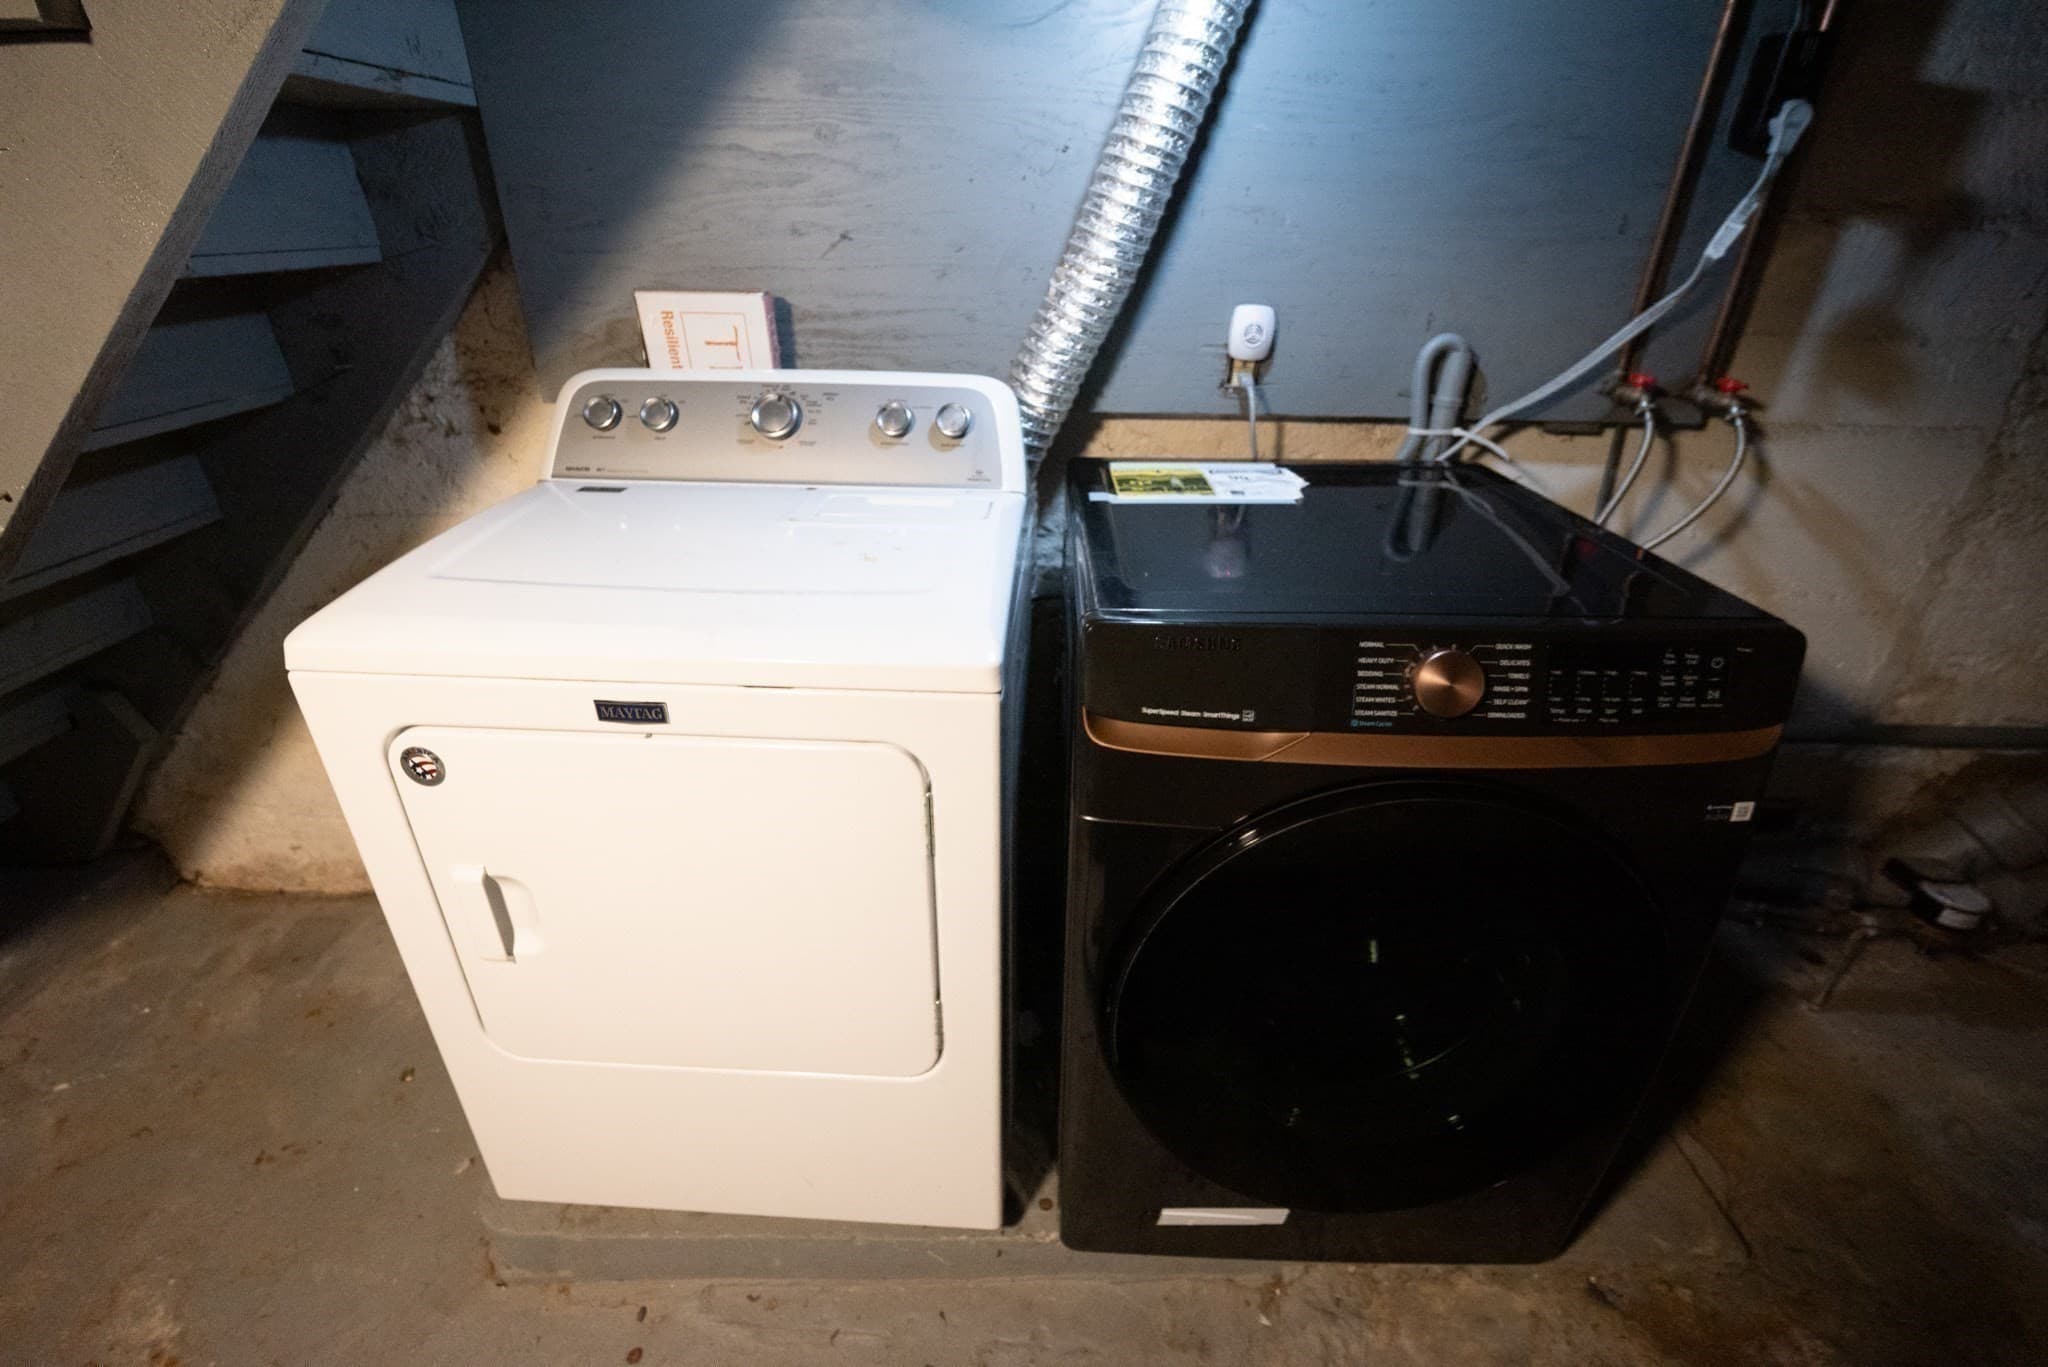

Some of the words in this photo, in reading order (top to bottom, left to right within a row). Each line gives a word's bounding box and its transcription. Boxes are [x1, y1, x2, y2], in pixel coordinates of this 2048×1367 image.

[1378, 657, 1394, 665] DUTY
[1499, 659, 1531, 667] DELICATES
[598, 704, 664, 721] MAYTAG
[1141, 706, 1180, 716] SuperSpeed
[1181, 709, 1202, 718] Steam
[1203, 711, 1240, 721] SmartThings
